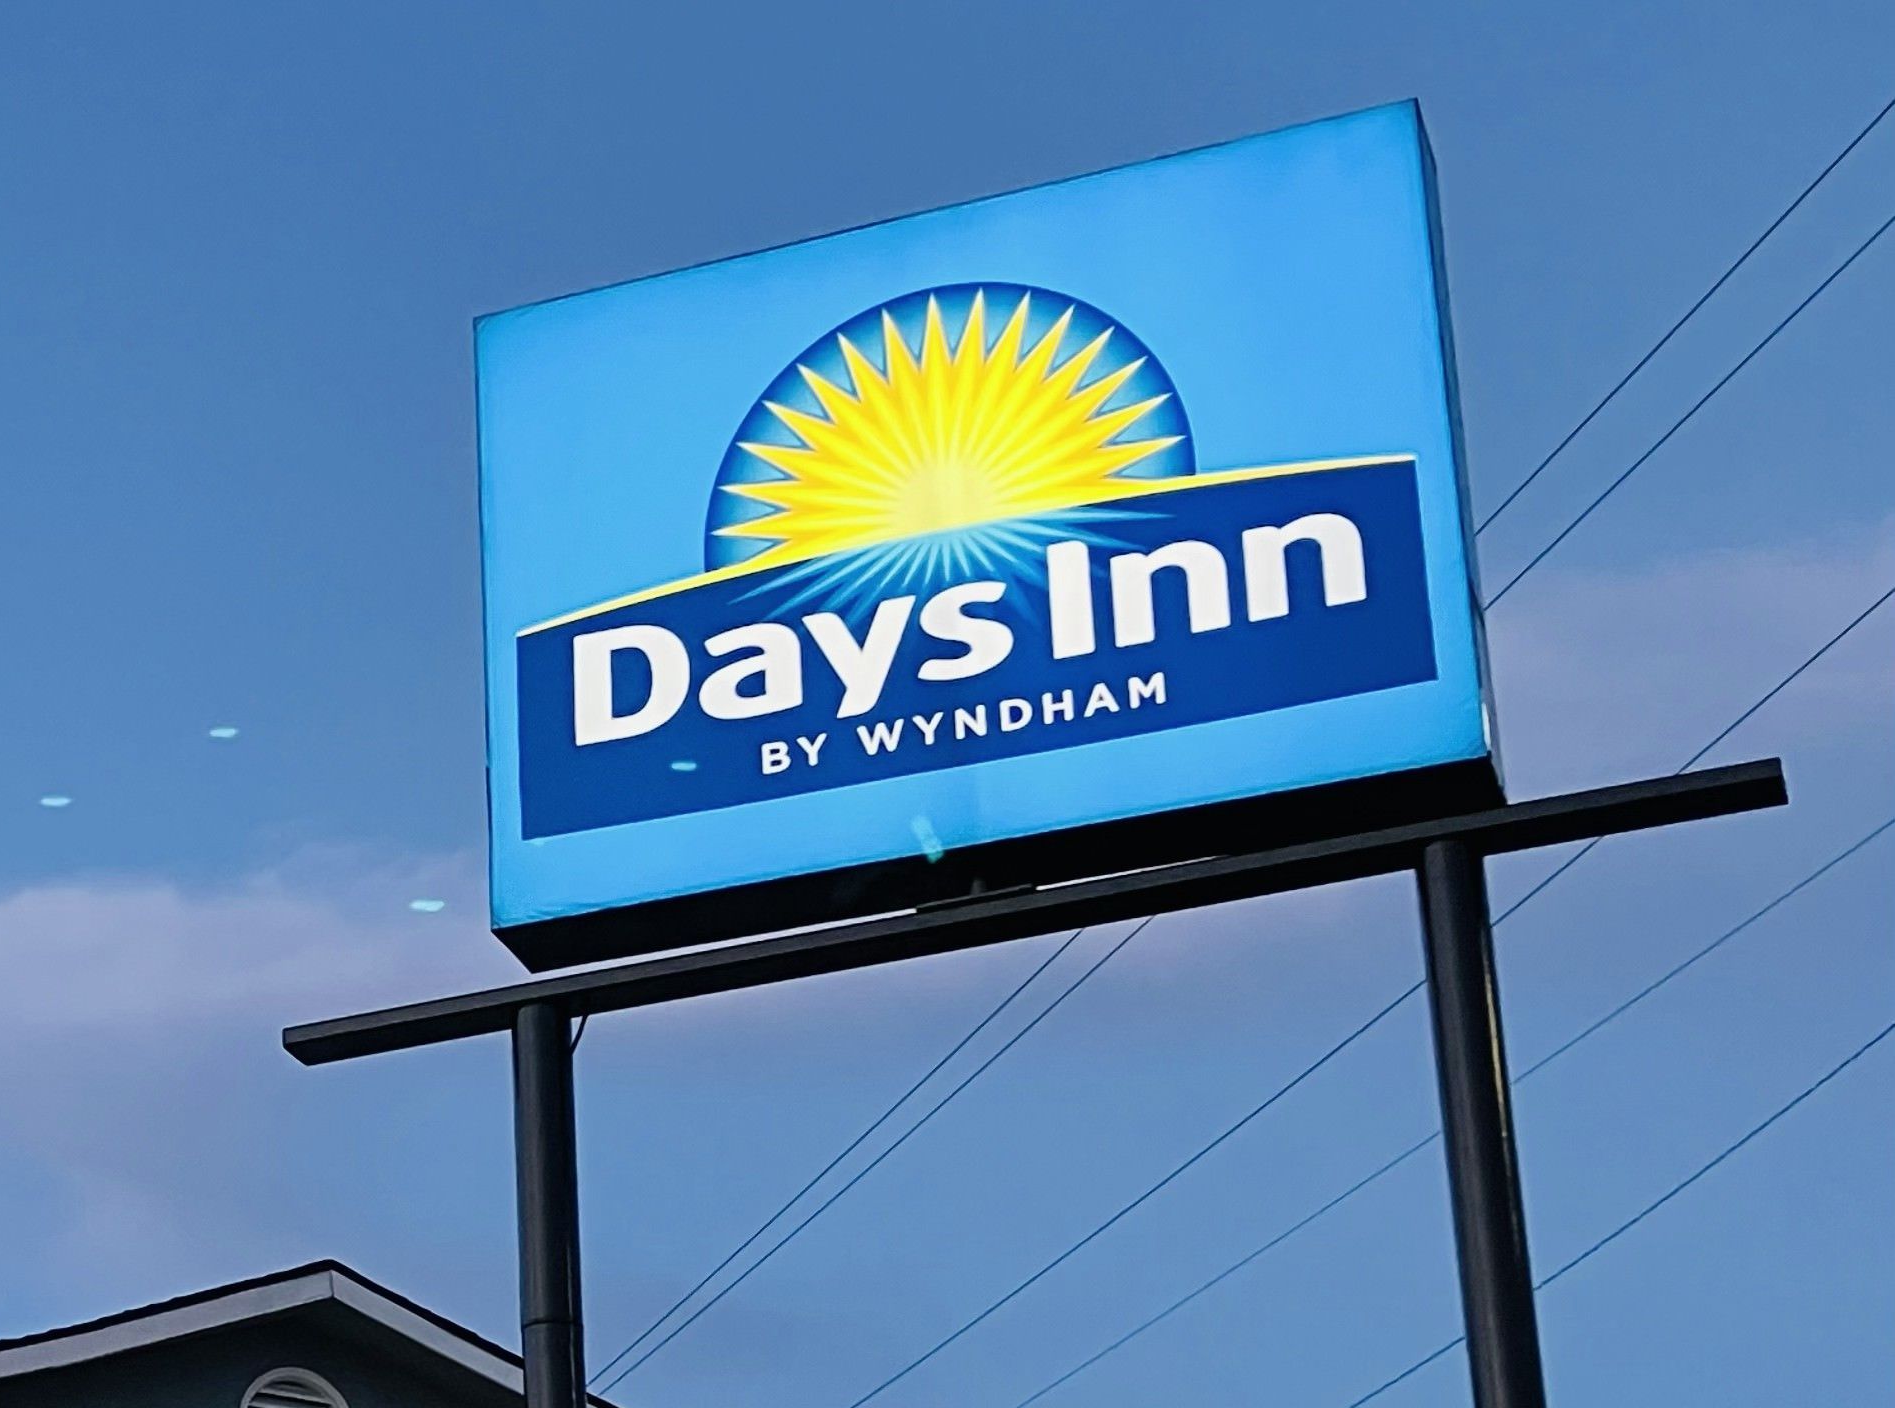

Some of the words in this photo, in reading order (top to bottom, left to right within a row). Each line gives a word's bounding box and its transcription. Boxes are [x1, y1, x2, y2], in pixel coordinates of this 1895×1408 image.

[572, 580, 1015, 748] Days
[1046, 511, 1369, 661] Inn
[761, 731, 830, 776] BY
[856, 672, 1168, 756] WYNDHAM
